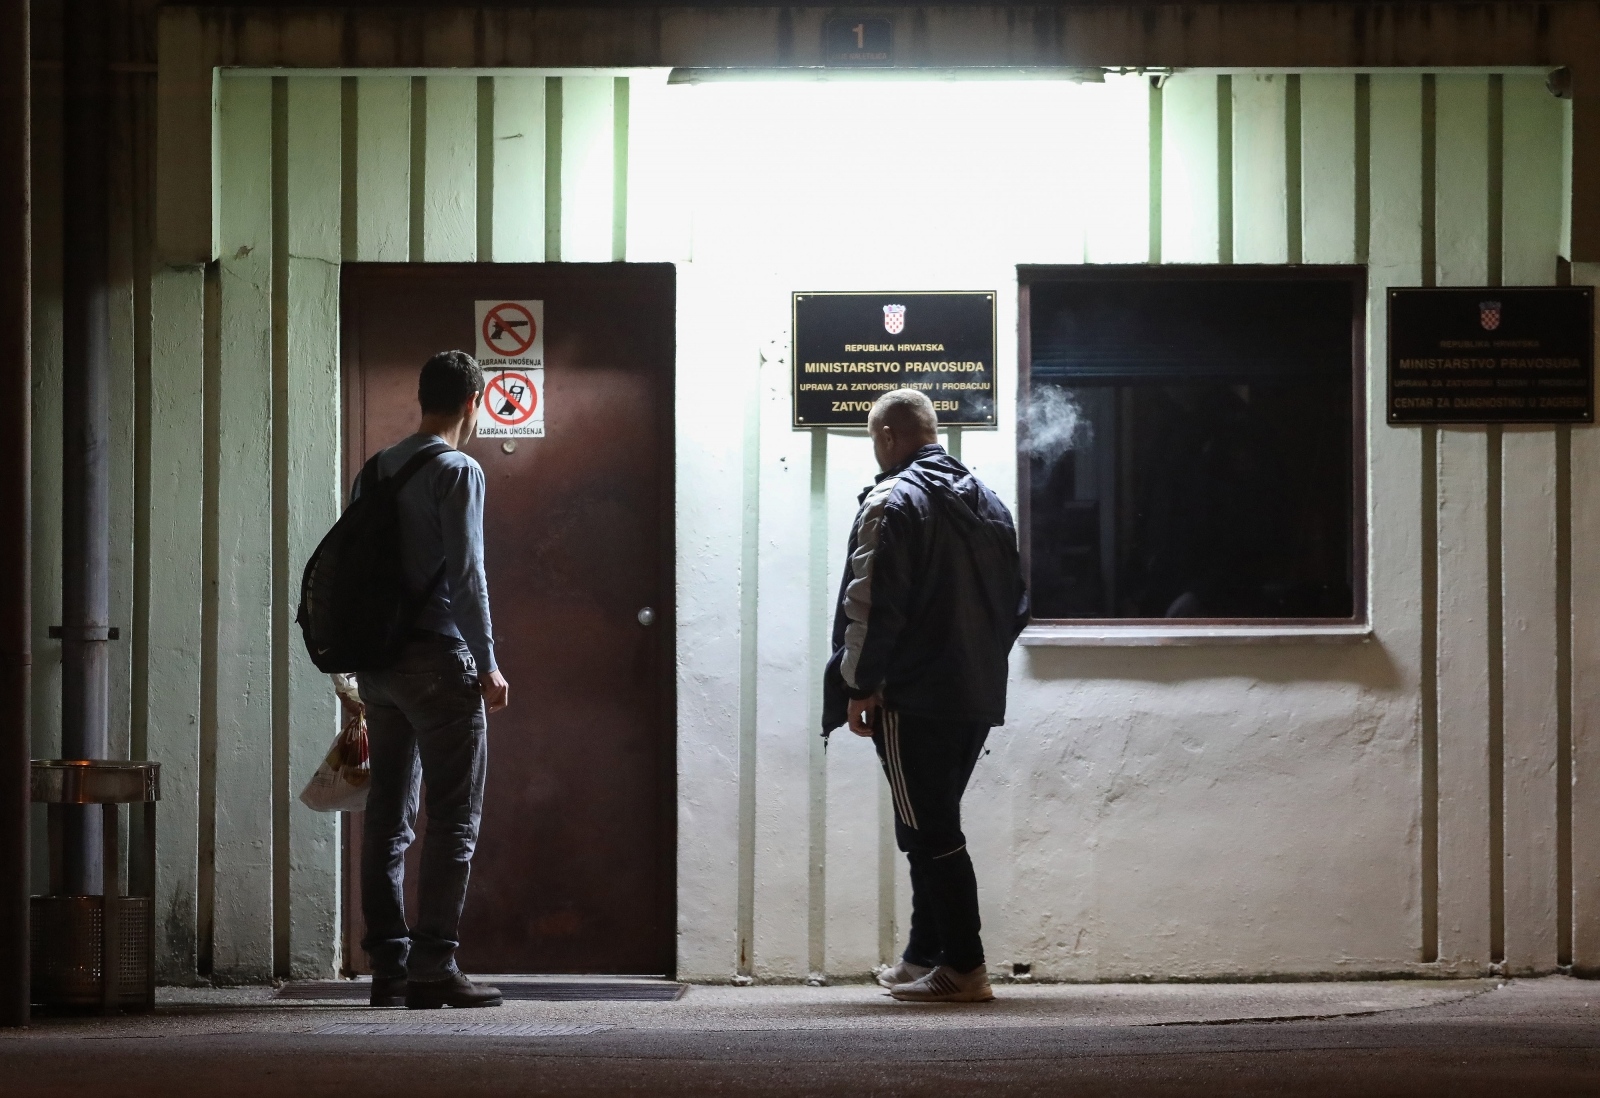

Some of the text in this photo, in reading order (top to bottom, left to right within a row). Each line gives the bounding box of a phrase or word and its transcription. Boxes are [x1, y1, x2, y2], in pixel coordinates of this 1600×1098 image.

[852, 23, 864, 49] 1
[845, 343, 944, 352] REPUBLIKA HRVATSKA
[1440, 340, 1491, 348] REPUBLIKA
[478, 357, 542, 367] ZABRANA UNOŠENJA
[805, 361, 984, 373] MINISTARSTVO PRAVOSUĐA
[1399, 358, 1496, 369] MINISTARSTVO
[800, 383, 833, 391] UPRAVA
[836, 383, 848, 391] ZA
[851, 383, 898, 391] ZATVORSKI
[901, 382, 933, 390] SUSTAV
[942, 382, 990, 390] PROBACIJU
[832, 401, 876, 412] ZATVO
[1394, 397, 1434, 408] CENTAR
[1437, 397, 1450, 408] ZA
[1529, 397, 1536, 408] U
[1539, 396, 1587, 407] ZAGREBU
[479, 426, 543, 435] ZABRANA UNOŠENJA
